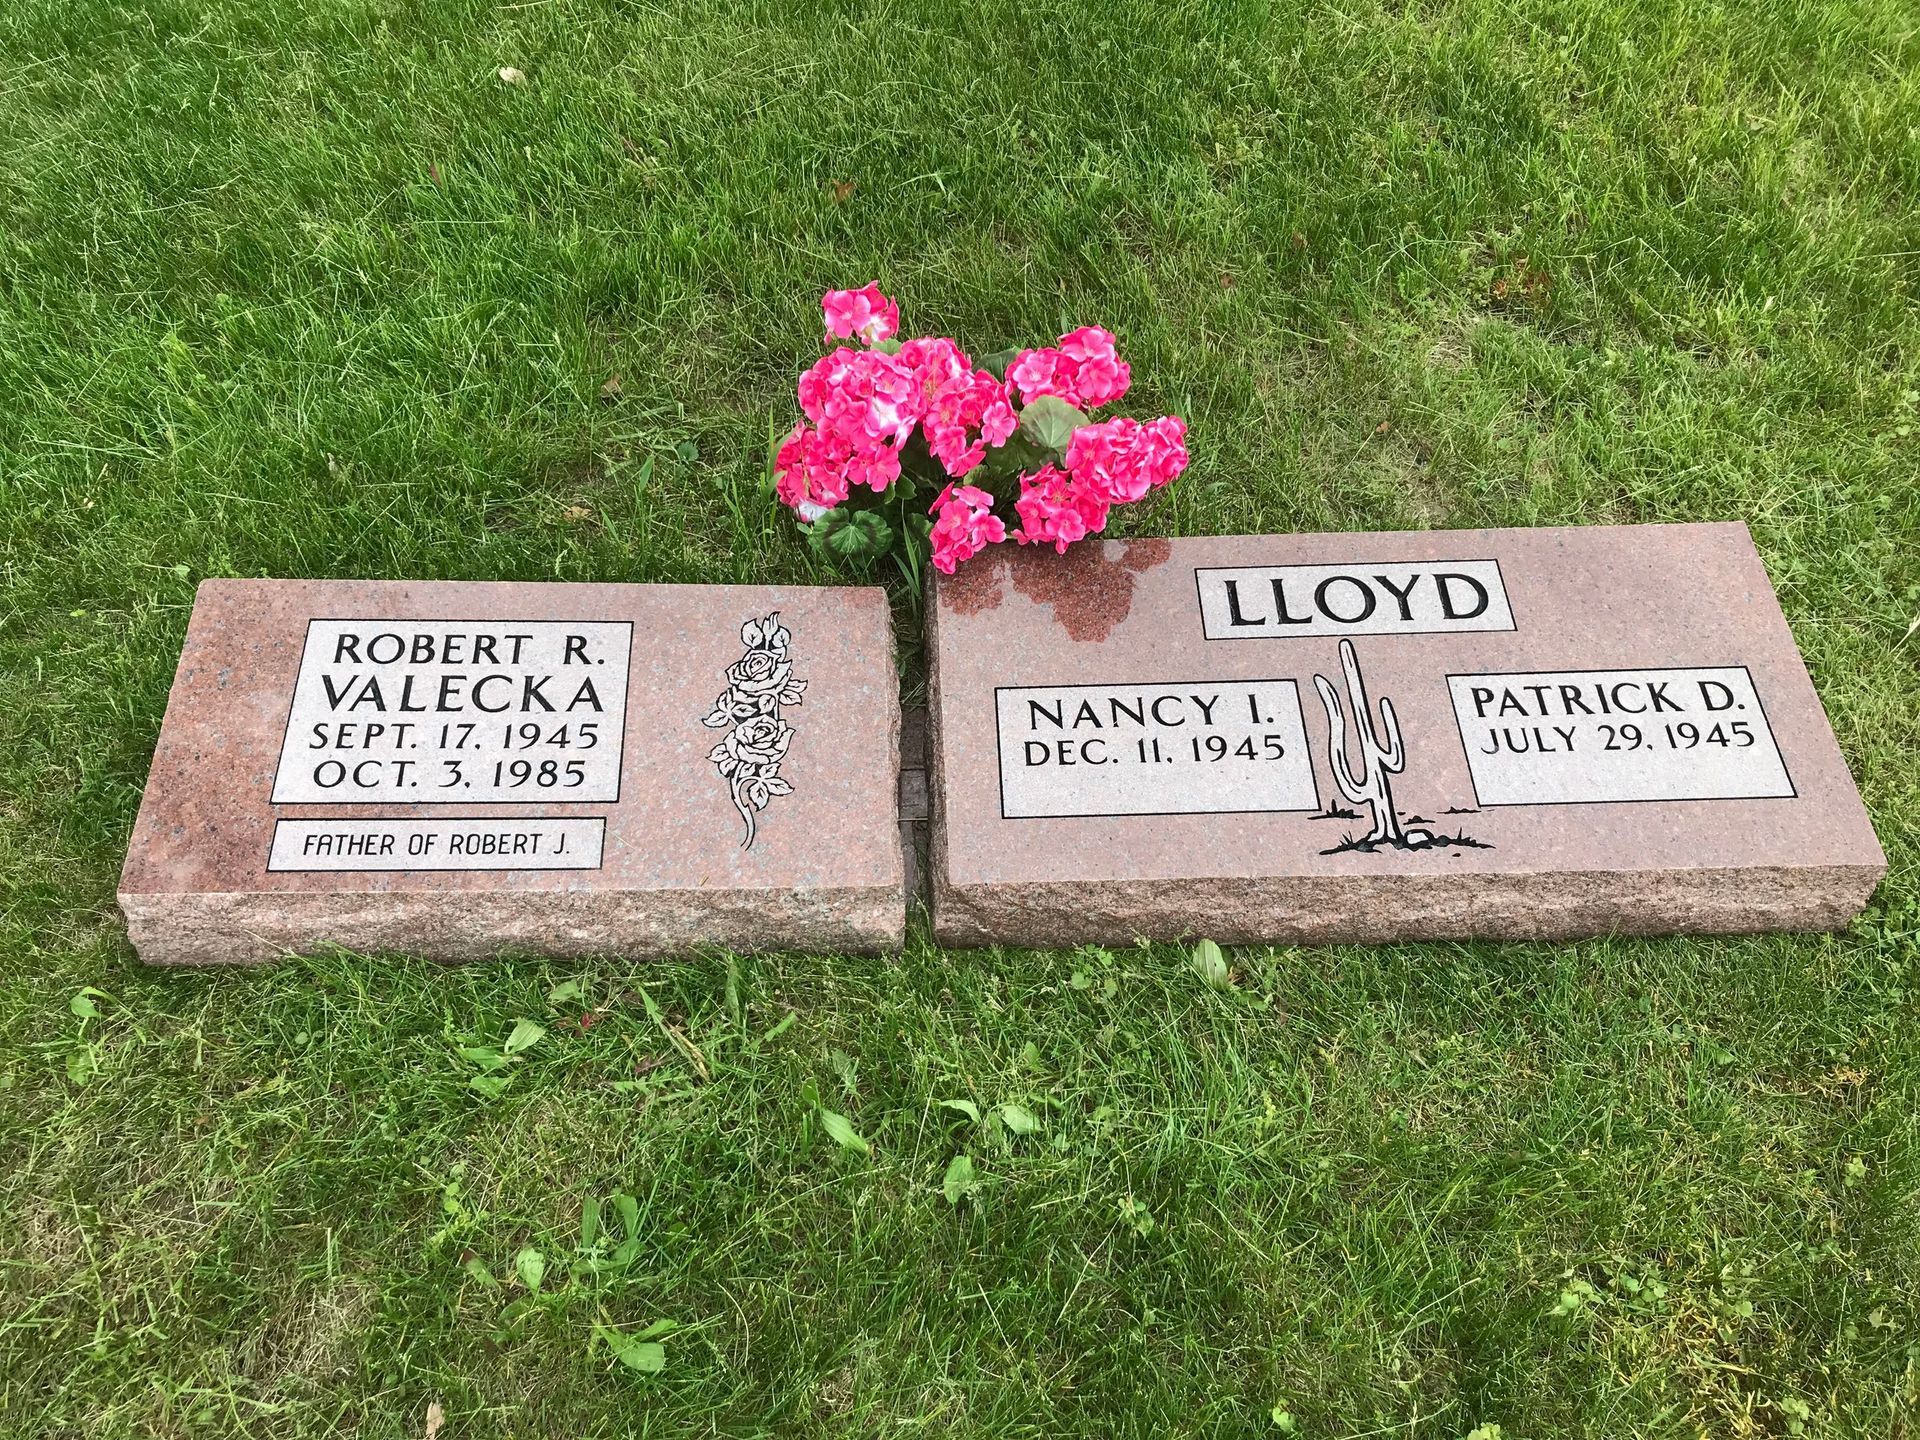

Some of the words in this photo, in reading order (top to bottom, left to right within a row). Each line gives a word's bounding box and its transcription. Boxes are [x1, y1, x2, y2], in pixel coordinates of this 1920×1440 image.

[1224, 573, 1490, 626] LLOYD
[333, 633, 534, 665] ROBERT
[562, 635, 605, 665] R.
[321, 674, 604, 713] VALECKA
[1470, 682, 1685, 718] PATRICK
[1696, 680, 1746, 711] D.
[1027, 694, 1220, 730] NANCY
[1247, 693, 1274, 724] I.
[309, 722, 417, 750] SEPT.
[439, 723, 481, 750] 17,
[503, 722, 599, 750] 1945
[1023, 738, 1119, 767] DEC.
[1137, 737, 1173, 764] 11,
[1191, 734, 1285, 763] 1945
[1480, 726, 1576, 755] JULY
[1597, 724, 1653, 751] 29,
[1664, 721, 1755, 749] 1945
[313, 760, 418, 789] OCT.
[438, 760, 471, 789] 3,
[493, 759, 586, 788] 1985
[303, 834, 395, 856] FATHER
[407, 833, 439, 856] OF
[449, 833, 543, 856] ROBERT
[553, 832, 571, 856] J.
